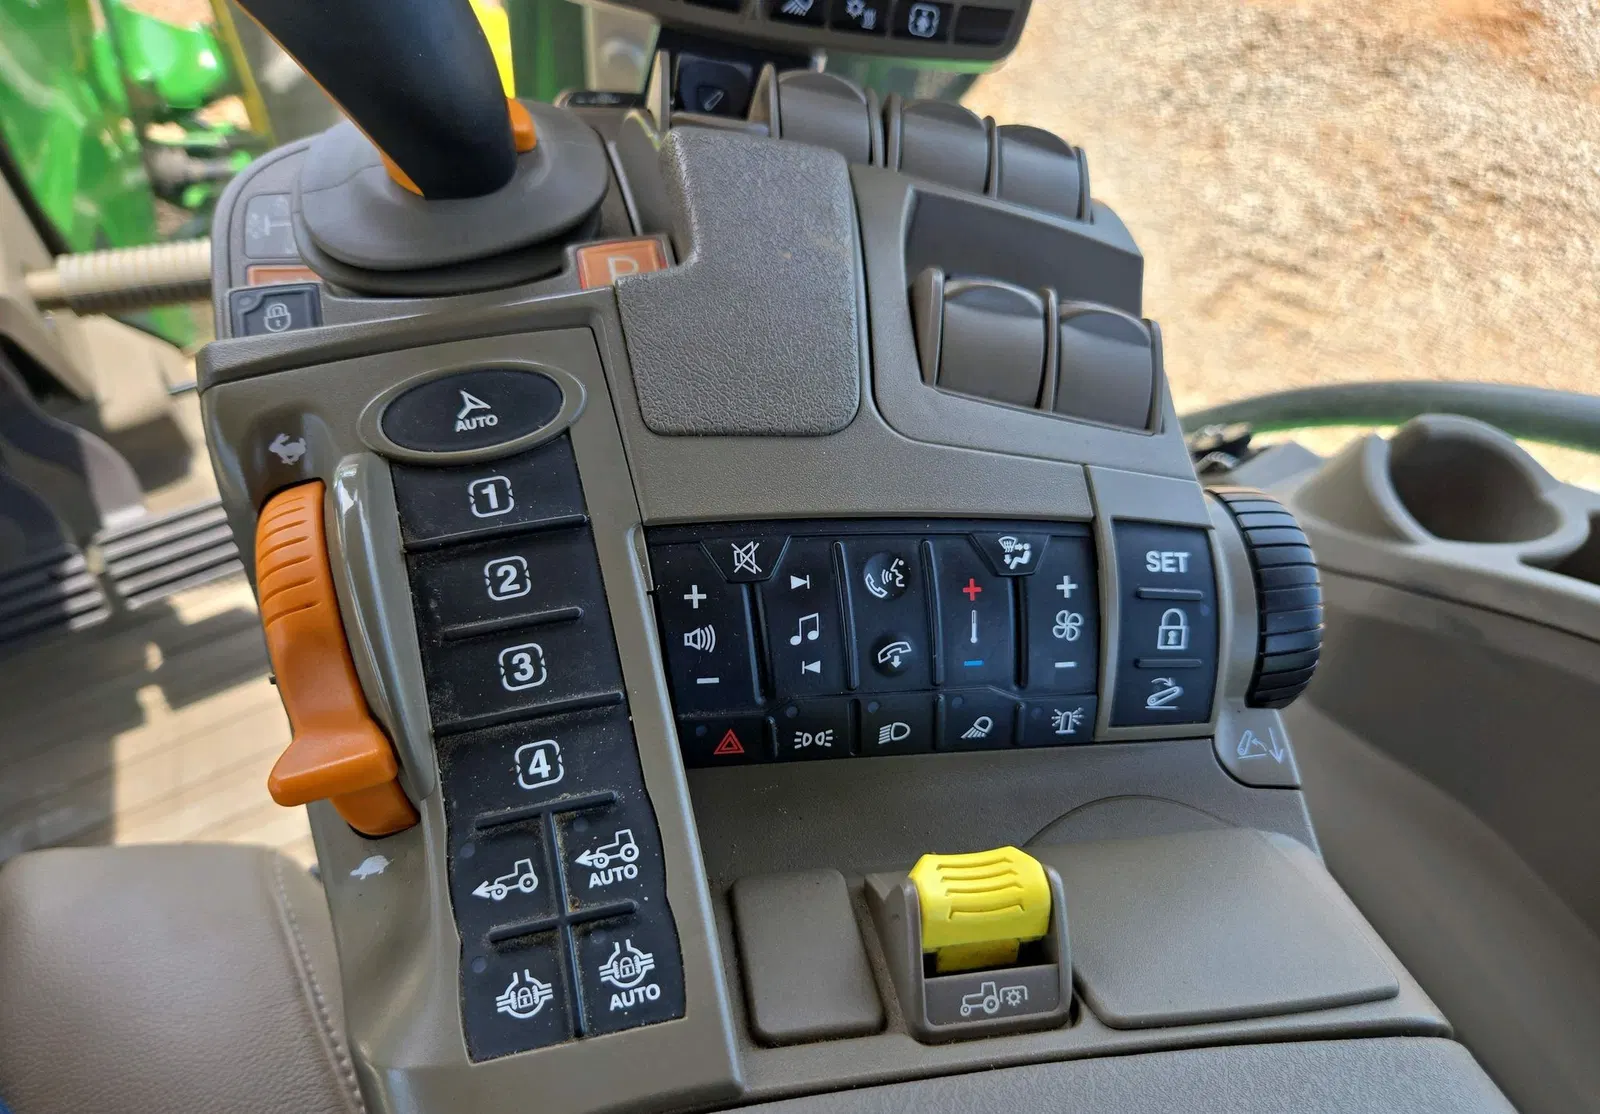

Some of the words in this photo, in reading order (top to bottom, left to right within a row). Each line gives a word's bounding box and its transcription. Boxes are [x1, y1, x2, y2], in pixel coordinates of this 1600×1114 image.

[455, 414, 499, 432] AUTO
[481, 483, 499, 509] 1
[1145, 550, 1191, 573] SET
[496, 565, 520, 593] 2
[512, 652, 535, 681] 3
[528, 749, 551, 779] 4
[588, 863, 639, 889] AUTO
[609, 982, 661, 1011] AUTO
